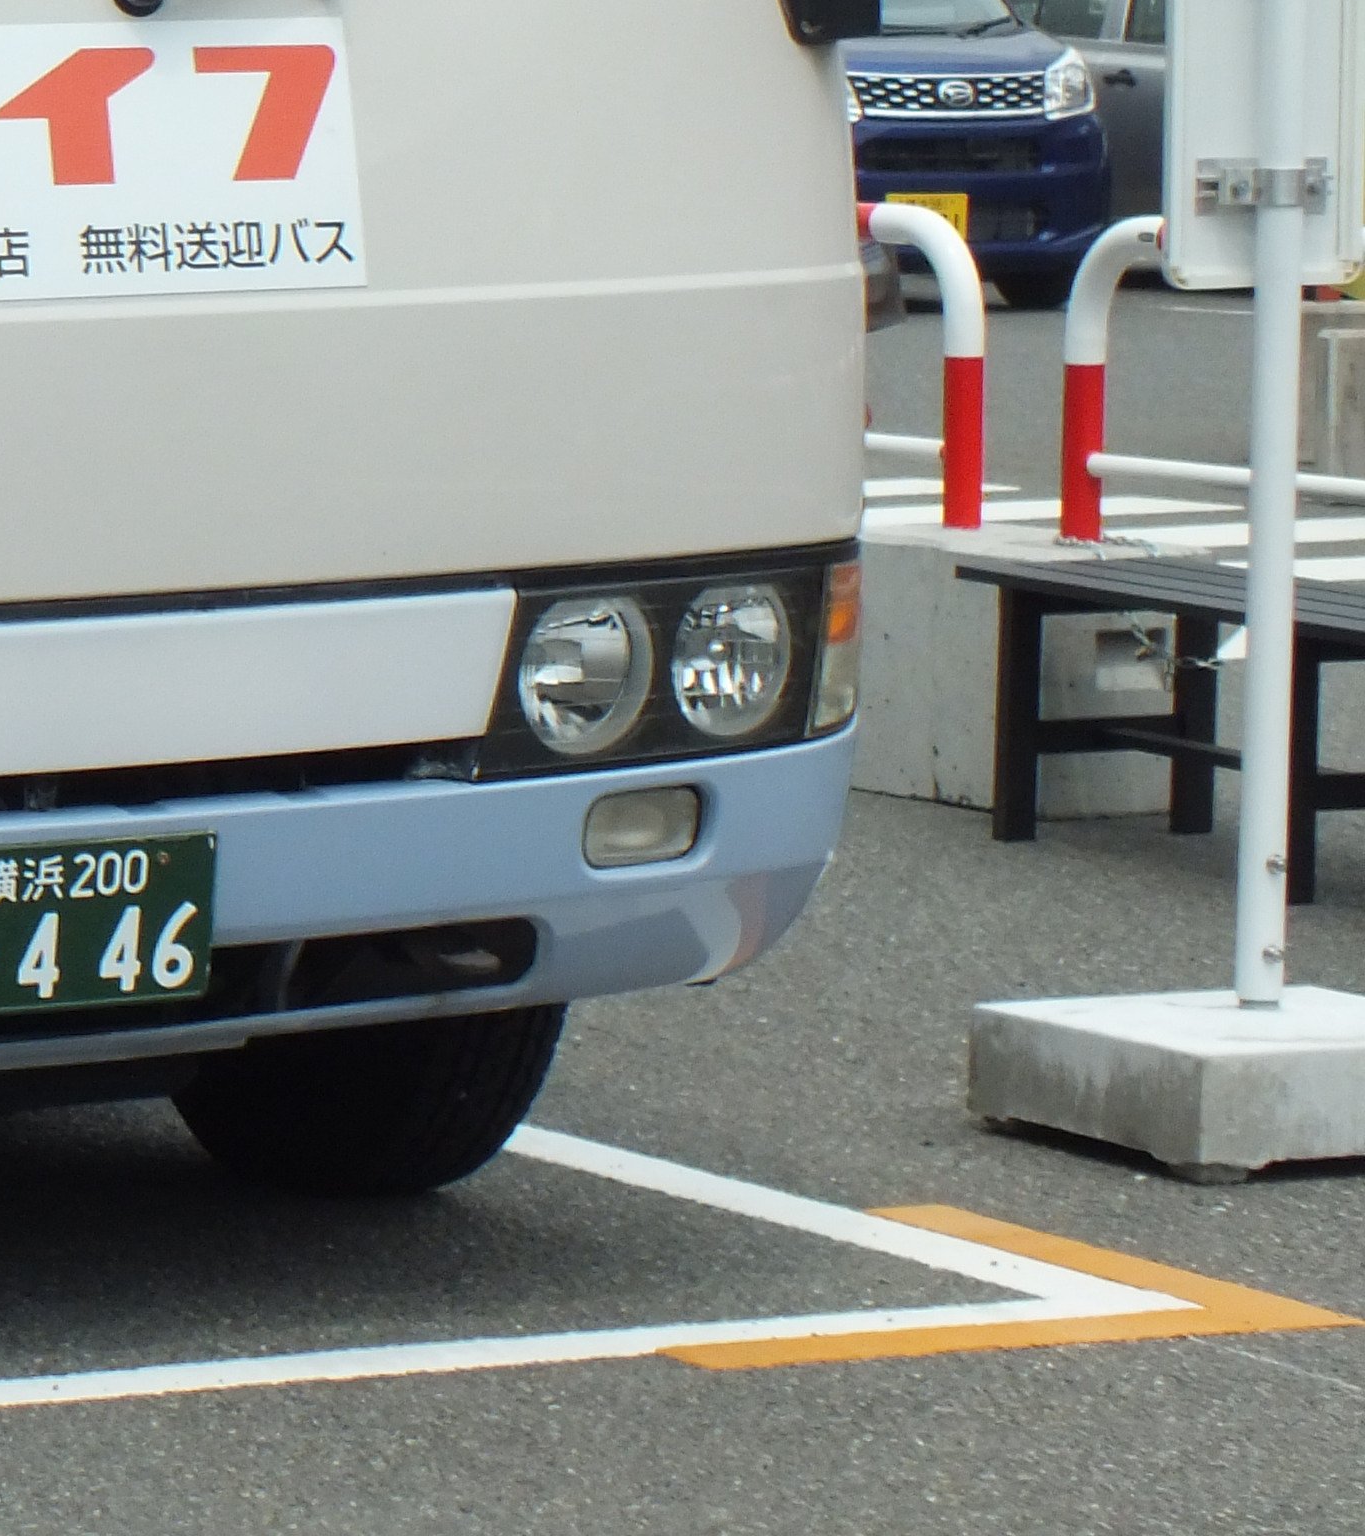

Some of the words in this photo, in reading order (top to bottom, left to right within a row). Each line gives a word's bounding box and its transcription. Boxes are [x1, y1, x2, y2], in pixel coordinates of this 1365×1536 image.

[79, 218, 357, 277] 無料送迎バス
